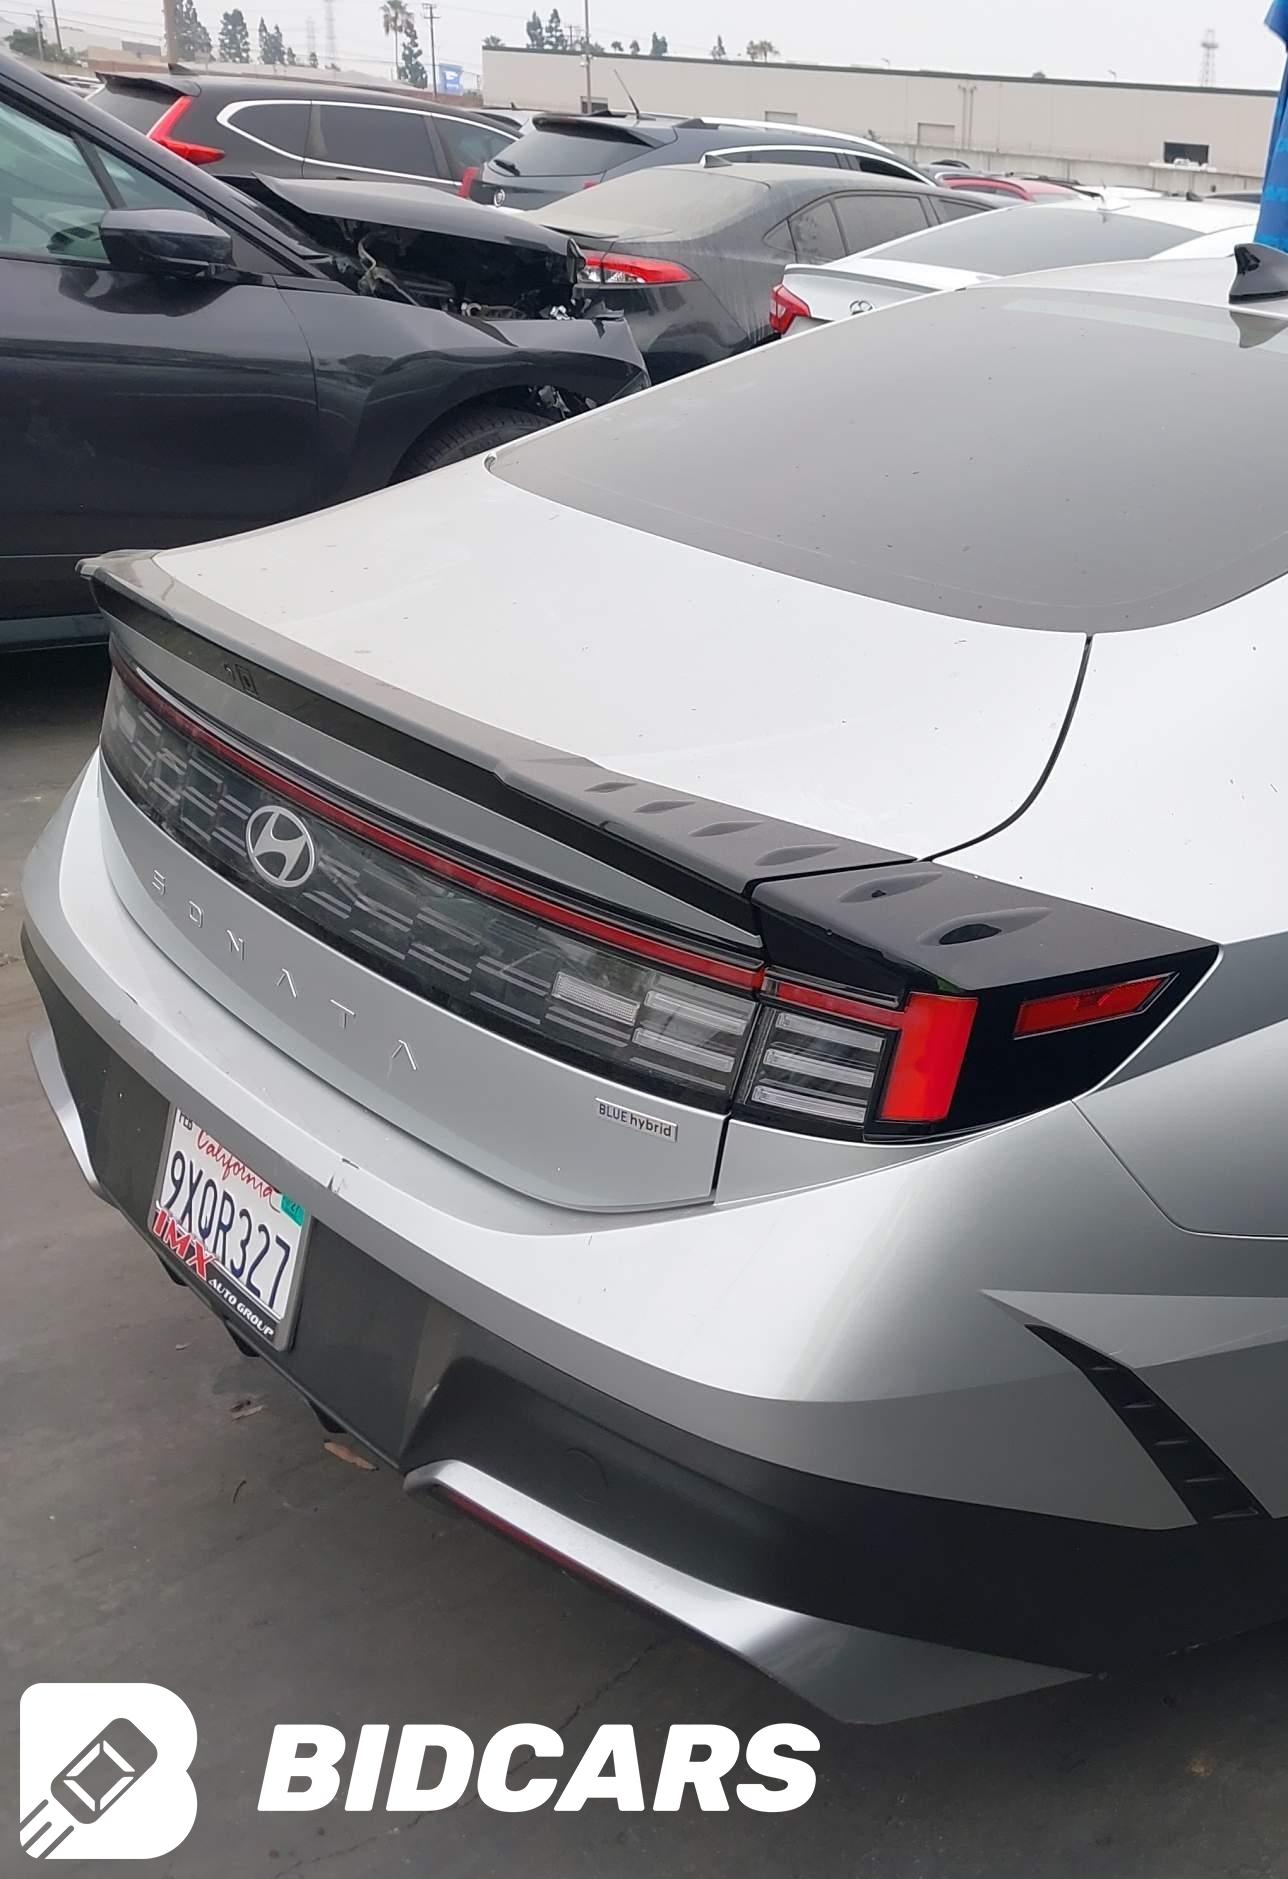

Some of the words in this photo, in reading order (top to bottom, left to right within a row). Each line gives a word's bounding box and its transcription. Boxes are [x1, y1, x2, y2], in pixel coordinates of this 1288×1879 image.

[152, 869, 418, 1071] SONATA
[599, 1103, 628, 1123] BLUE
[630, 1113, 672, 1137] hybrid
[197, 1129, 273, 1199] California
[162, 1150, 291, 1310] 9XQR327
[208, 1278, 237, 1305] AUTO
[236, 1302, 275, 1336] GROUP
